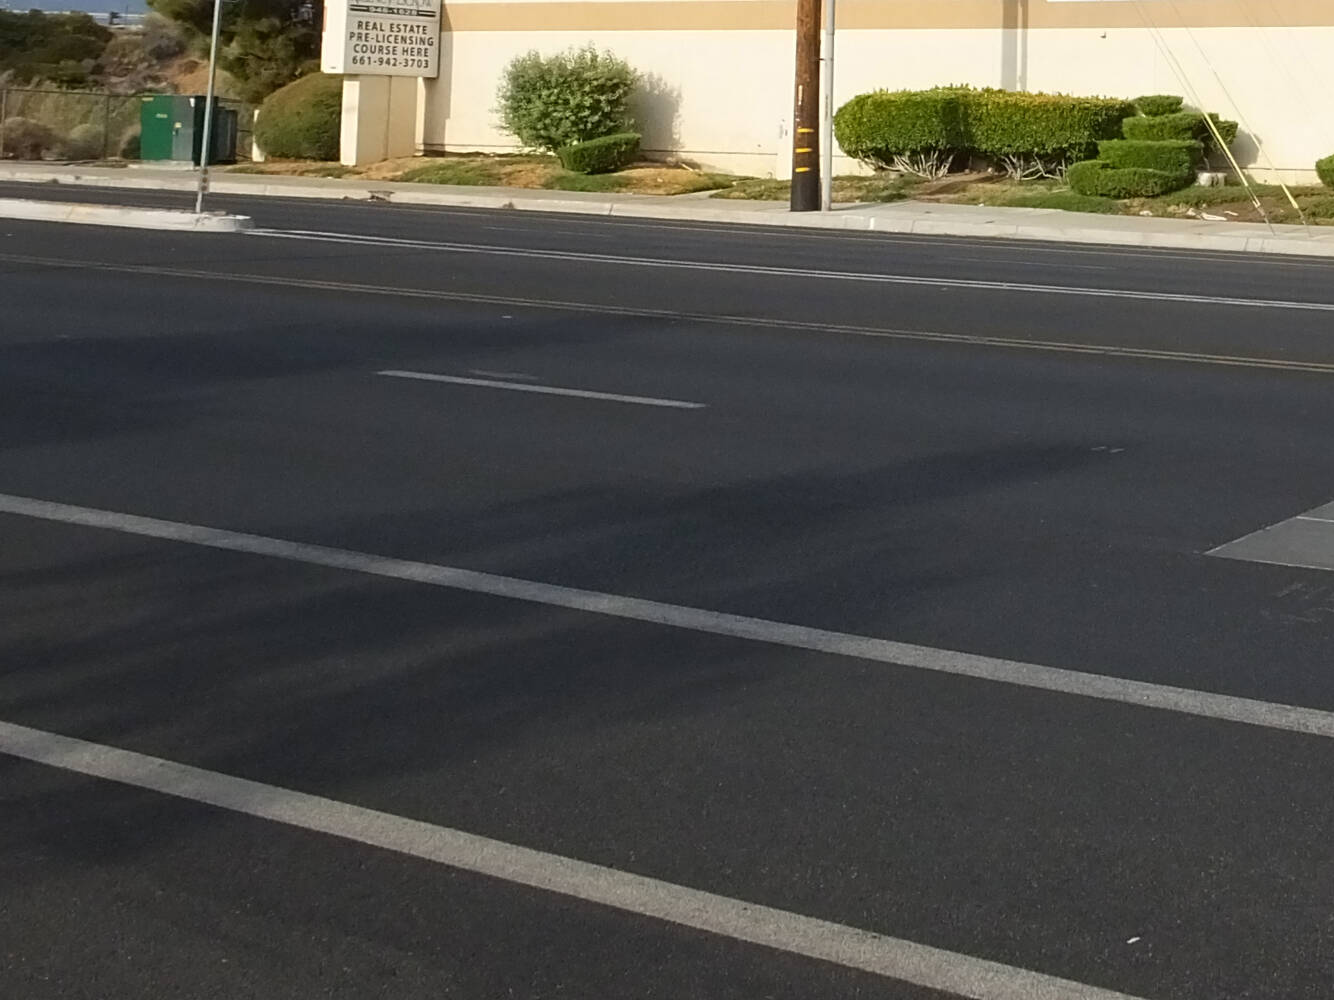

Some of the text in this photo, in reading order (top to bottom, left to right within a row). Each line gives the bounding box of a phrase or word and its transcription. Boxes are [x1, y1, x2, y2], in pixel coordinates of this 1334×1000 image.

[357, 20, 428, 35] REAL ESTATE
[349, 31, 434, 47] PRE-LICENSING
[353, 43, 429, 58] COURSE HERE
[352, 55, 429, 69] 661-942-3703
